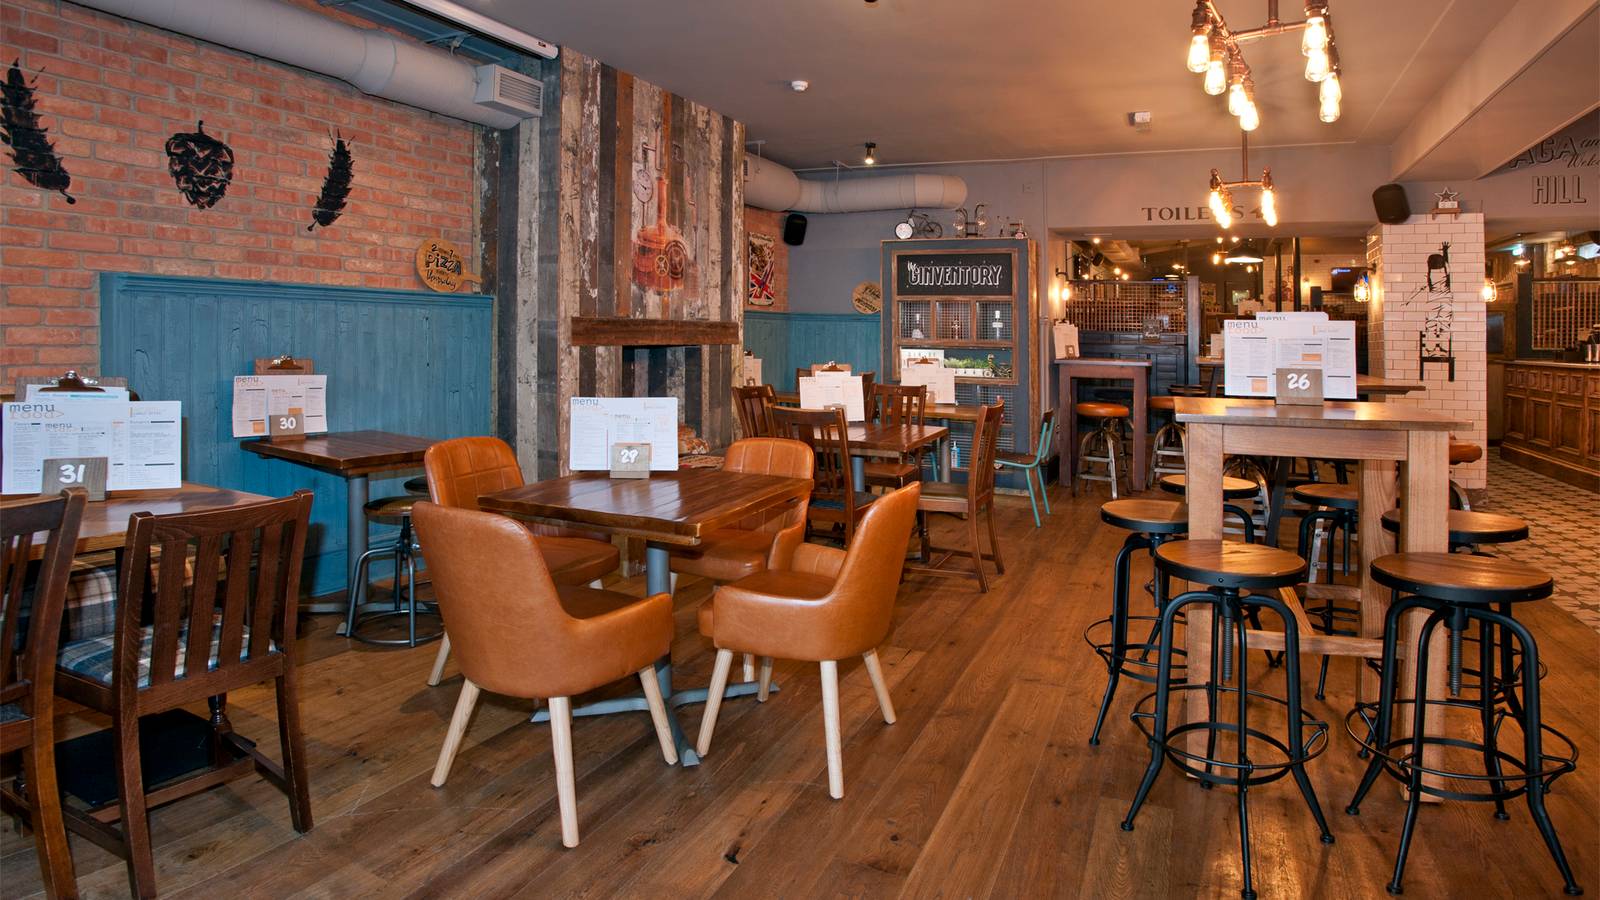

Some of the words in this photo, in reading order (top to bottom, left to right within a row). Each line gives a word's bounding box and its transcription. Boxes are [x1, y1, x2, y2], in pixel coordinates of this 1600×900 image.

[1532, 175, 1587, 204] HILL
[1141, 206, 1245, 221] TOILES
[908, 264, 1002, 286] GINVENTORY
[1227, 321, 1259, 329] menu
[1286, 373, 1311, 390] 26
[9, 403, 55, 413] menu
[572, 398, 599, 406] menu
[279, 417, 297, 429] 30
[620, 448, 639, 464] 29
[59, 464, 87, 484] 31
